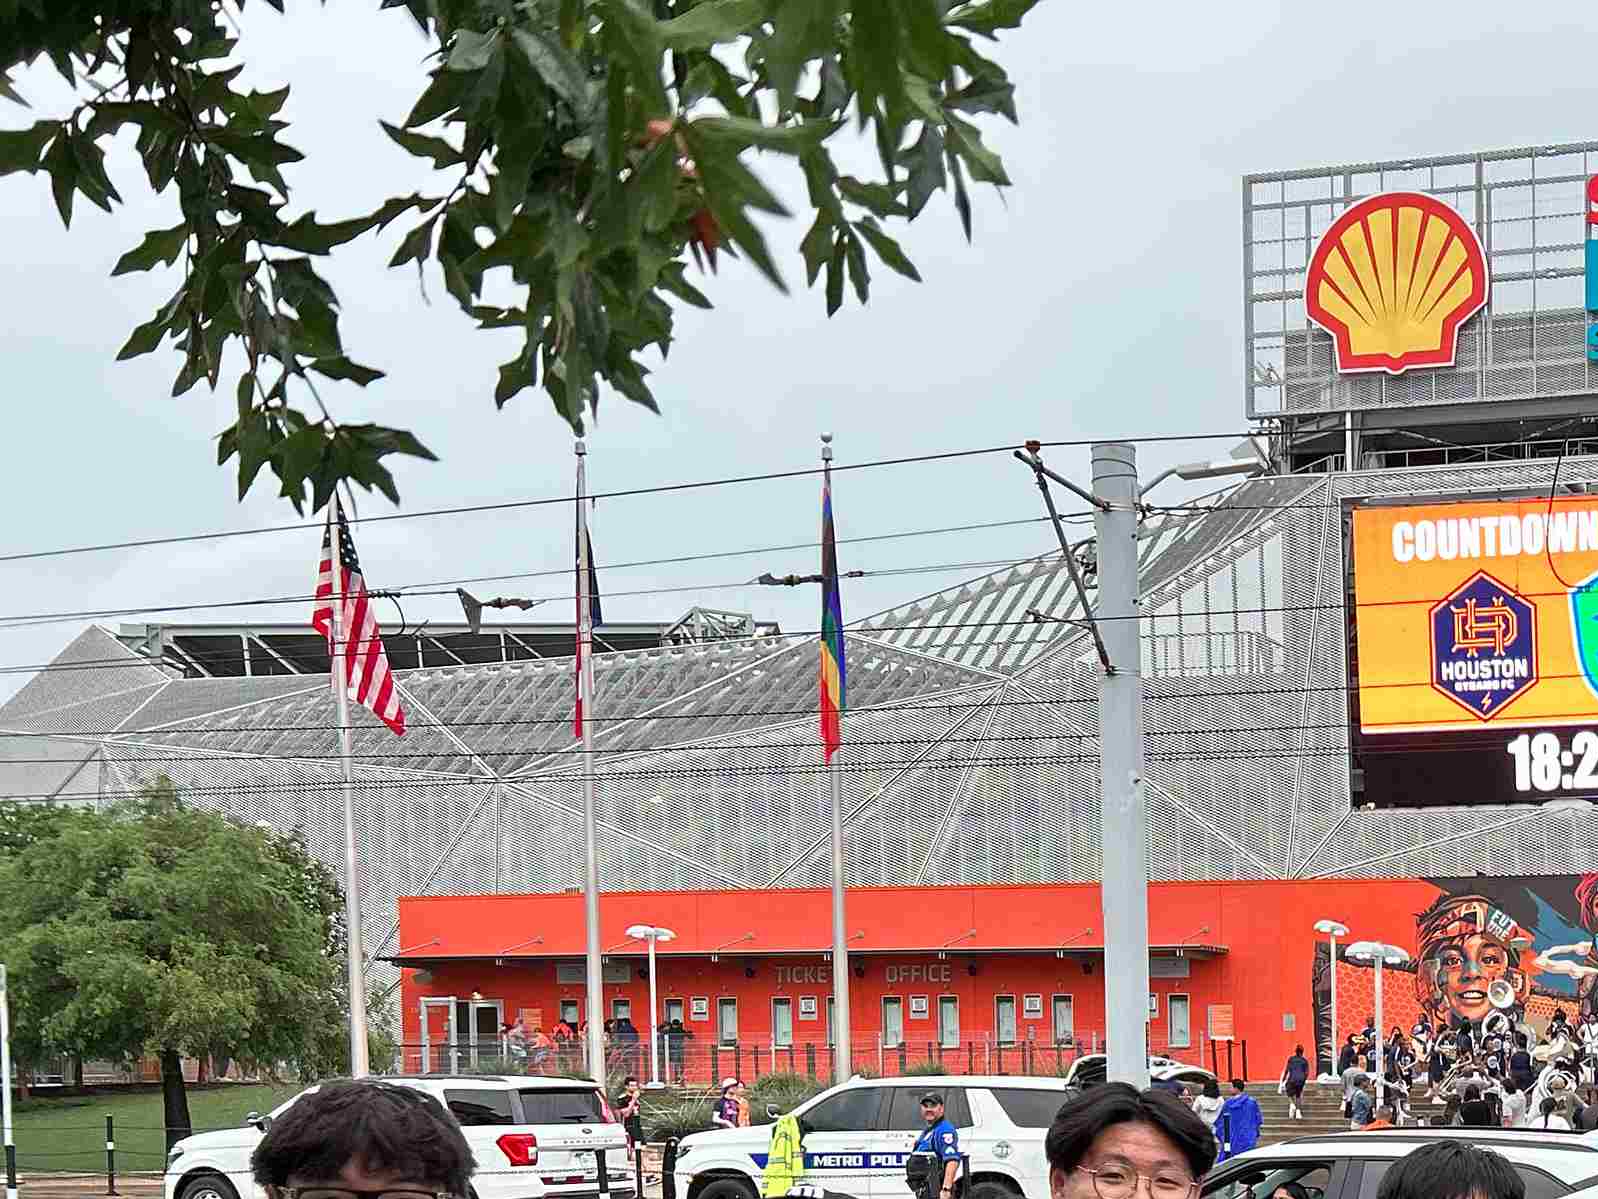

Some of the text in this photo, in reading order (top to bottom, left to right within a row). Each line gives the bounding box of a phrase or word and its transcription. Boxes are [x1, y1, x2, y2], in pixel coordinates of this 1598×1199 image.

[1441, 658, 1529, 681] HOUSTON
[1500, 679, 1515, 690] FC
[775, 963, 952, 984] TICKE OFFICE
[813, 1154, 911, 1167] METRO POLI
